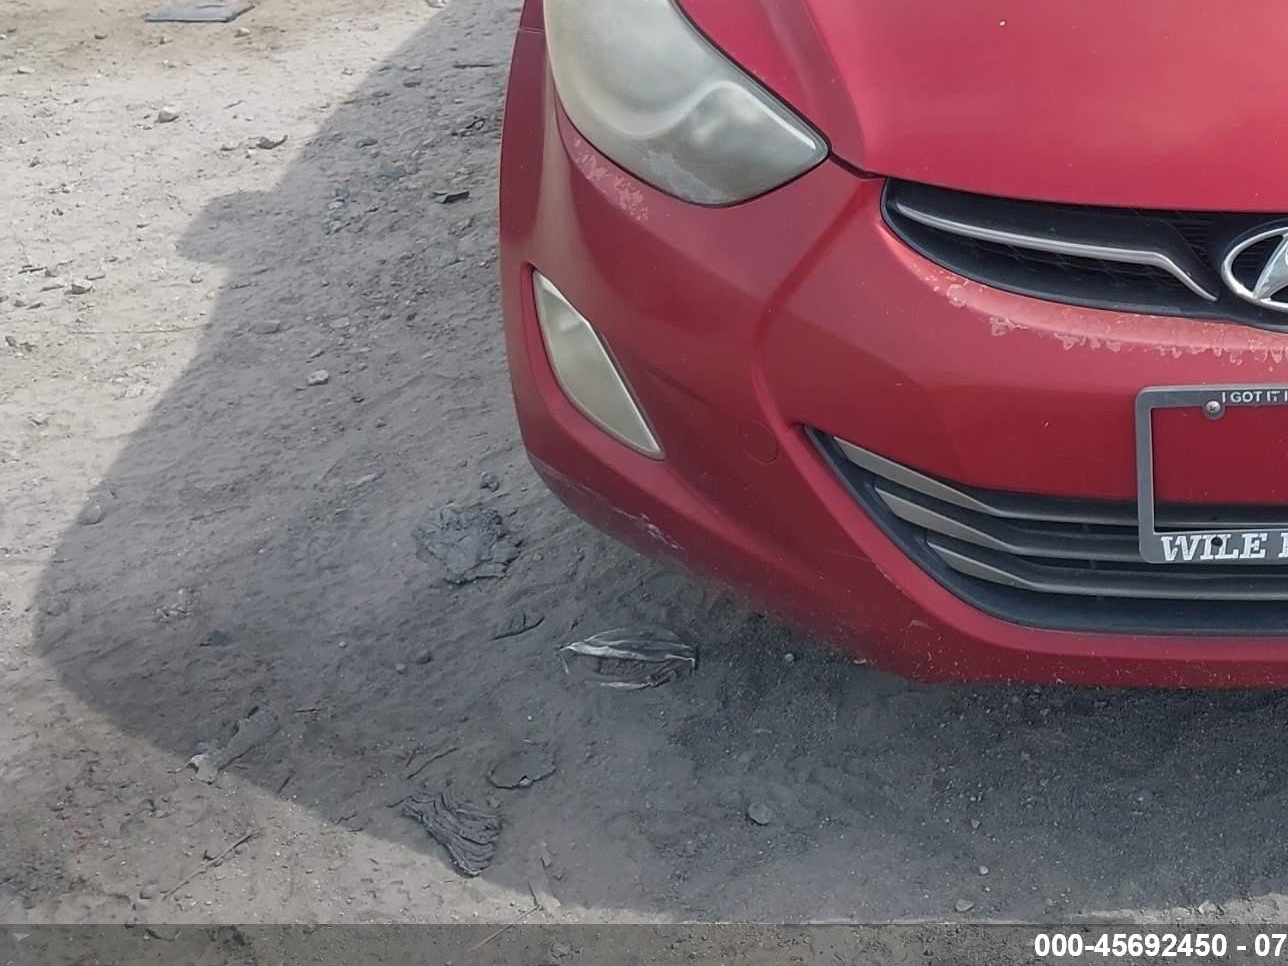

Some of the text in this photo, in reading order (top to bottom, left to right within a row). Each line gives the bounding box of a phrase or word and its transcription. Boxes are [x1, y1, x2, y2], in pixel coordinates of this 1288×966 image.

[1222, 391, 1227, 403] I
[1230, 390, 1262, 403] GOT
[1266, 390, 1281, 403] IT
[1161, 533, 1267, 562] WILE
